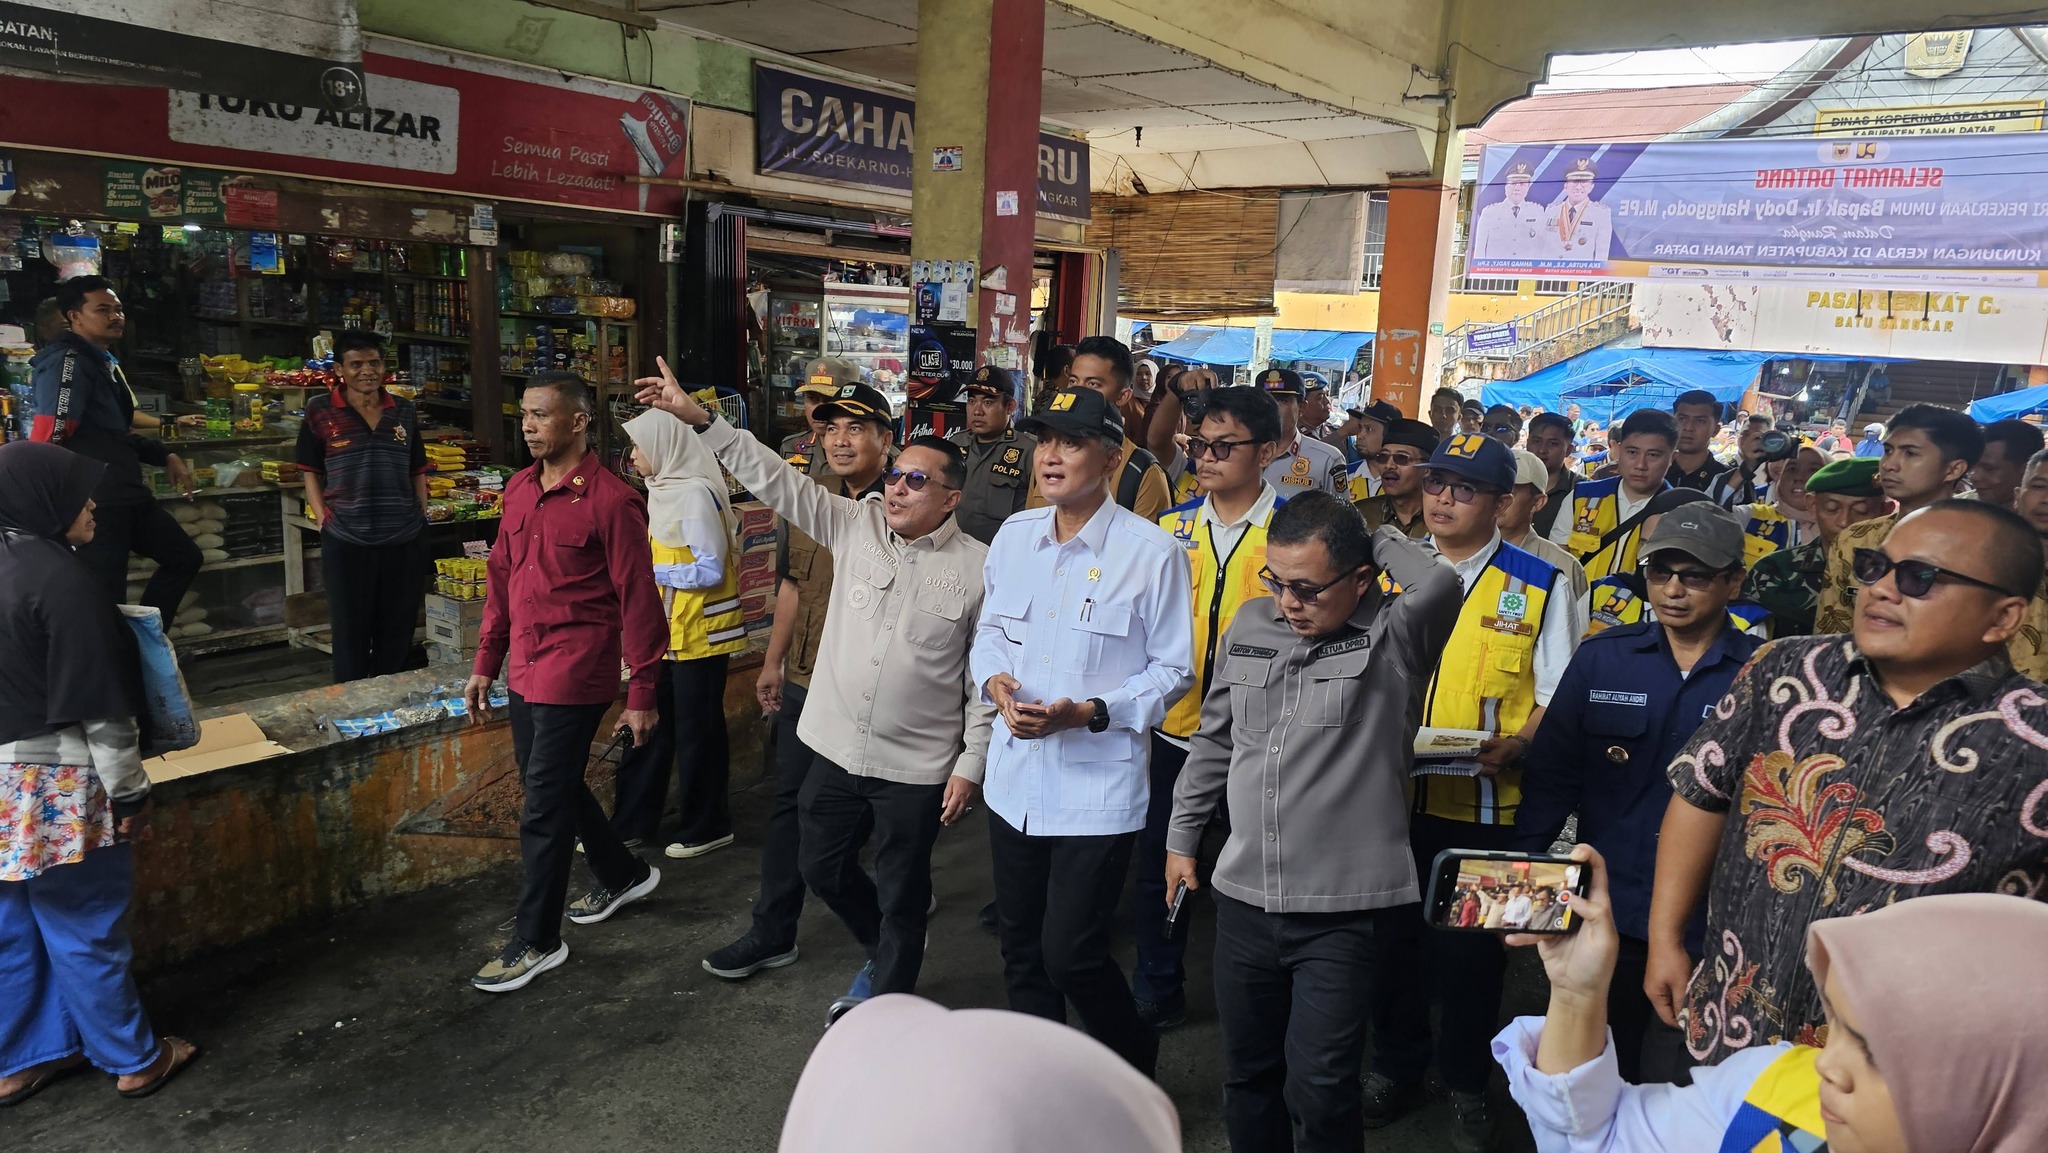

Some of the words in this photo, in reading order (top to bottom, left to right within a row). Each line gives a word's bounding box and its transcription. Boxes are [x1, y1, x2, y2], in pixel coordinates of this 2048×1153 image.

[326, 80, 356, 98] 18+
[314, 106, 441, 142] ALIZAR
[1831, 116, 1870, 127] DINAS
[1920, 127, 1956, 135] TANAH
[1959, 125, 1996, 134] DATAR
[502, 136, 561, 160] Semua
[569, 145, 610, 167] Pasti
[146, 174, 182, 190] MILO
[491, 159, 540, 182] Lebih
[546, 168, 616, 192] Lezaaat!
[1806, 291, 1874, 310] PASAR
[1877, 293, 1971, 313] SERIKAT
[775, 316, 816, 328] VITRON
[1834, 316, 1873, 328] BATU
[1878, 317, 1954, 332] SANGKAR
[992, 464, 1008, 474] POL
[1009, 468, 1020, 477] PP
[1283, 476, 1310, 486] DISHUB
[862, 541, 876, 554] EKA
[925, 576, 968, 597] BUPATI
[1493, 620, 1520, 631] JIHAT
[1319, 643, 1344, 656] KETUA
[1345, 638, 1366, 649] DPRD
